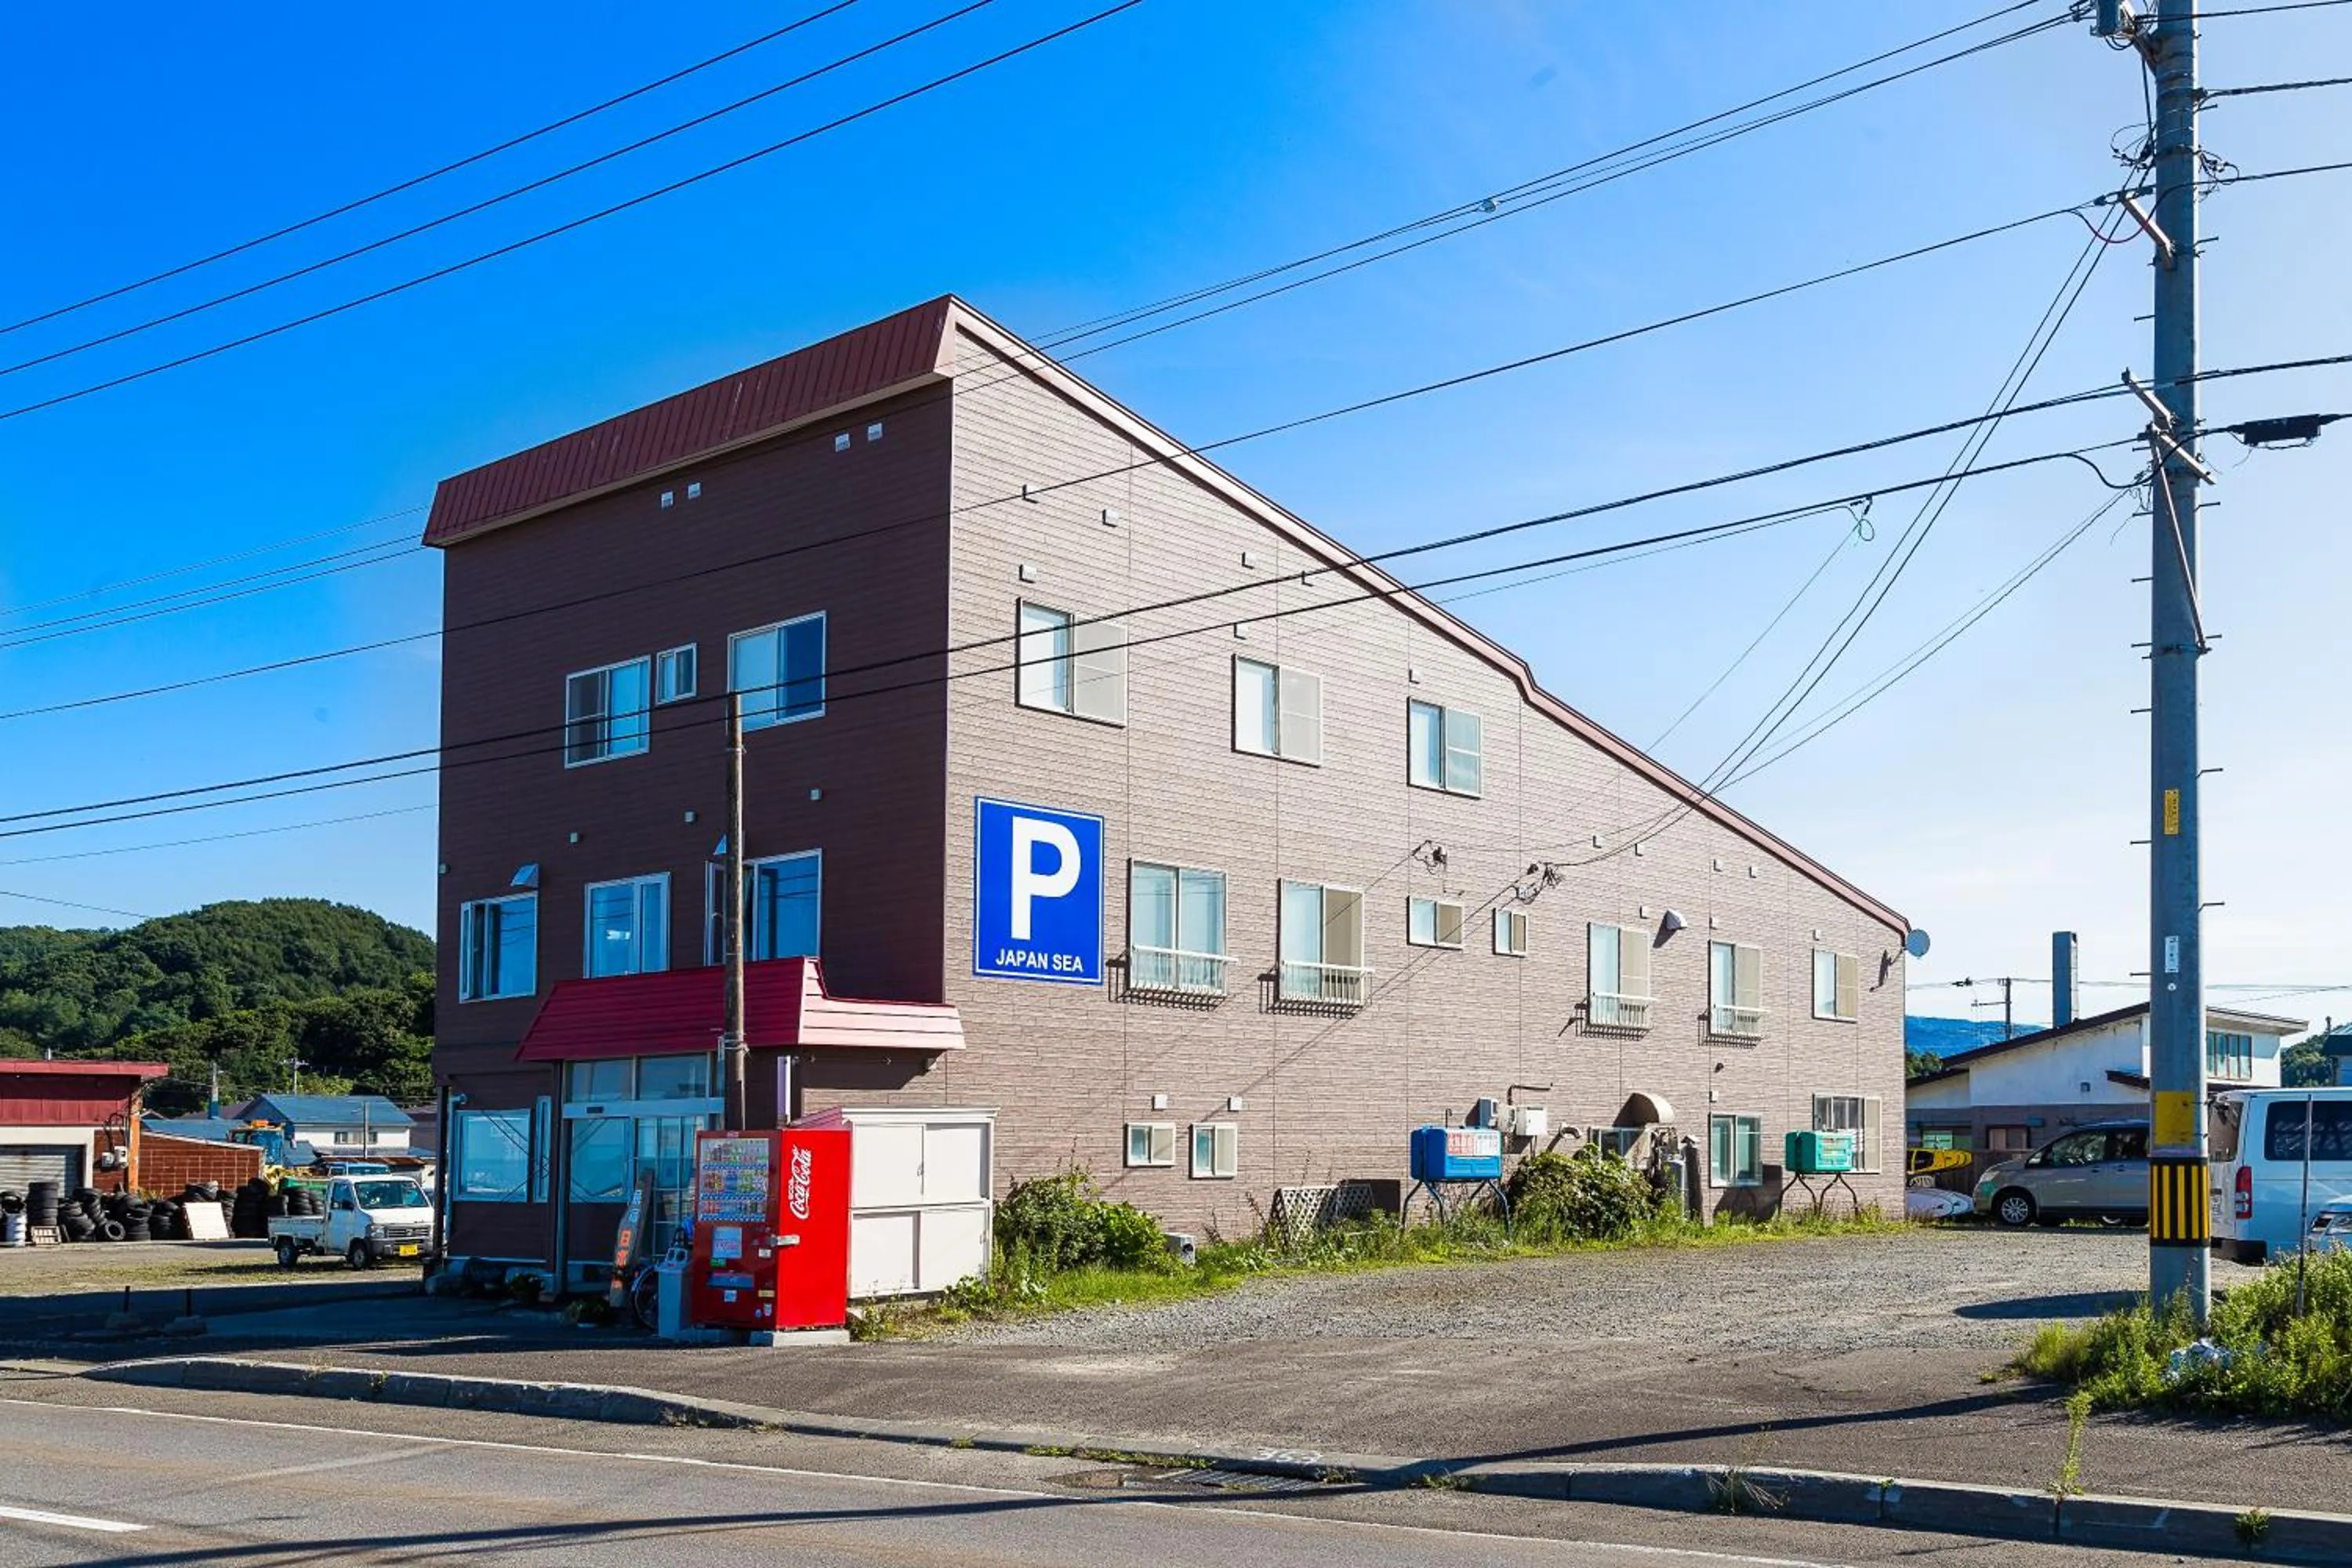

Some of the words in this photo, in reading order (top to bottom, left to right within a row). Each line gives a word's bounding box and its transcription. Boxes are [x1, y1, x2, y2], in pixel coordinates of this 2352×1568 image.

[1011, 815, 1081, 941] P
[995, 948, 1048, 970] JAPAN
[1052, 953, 1083, 973] SEA
[789, 1143, 812, 1220] Coca-Cola
